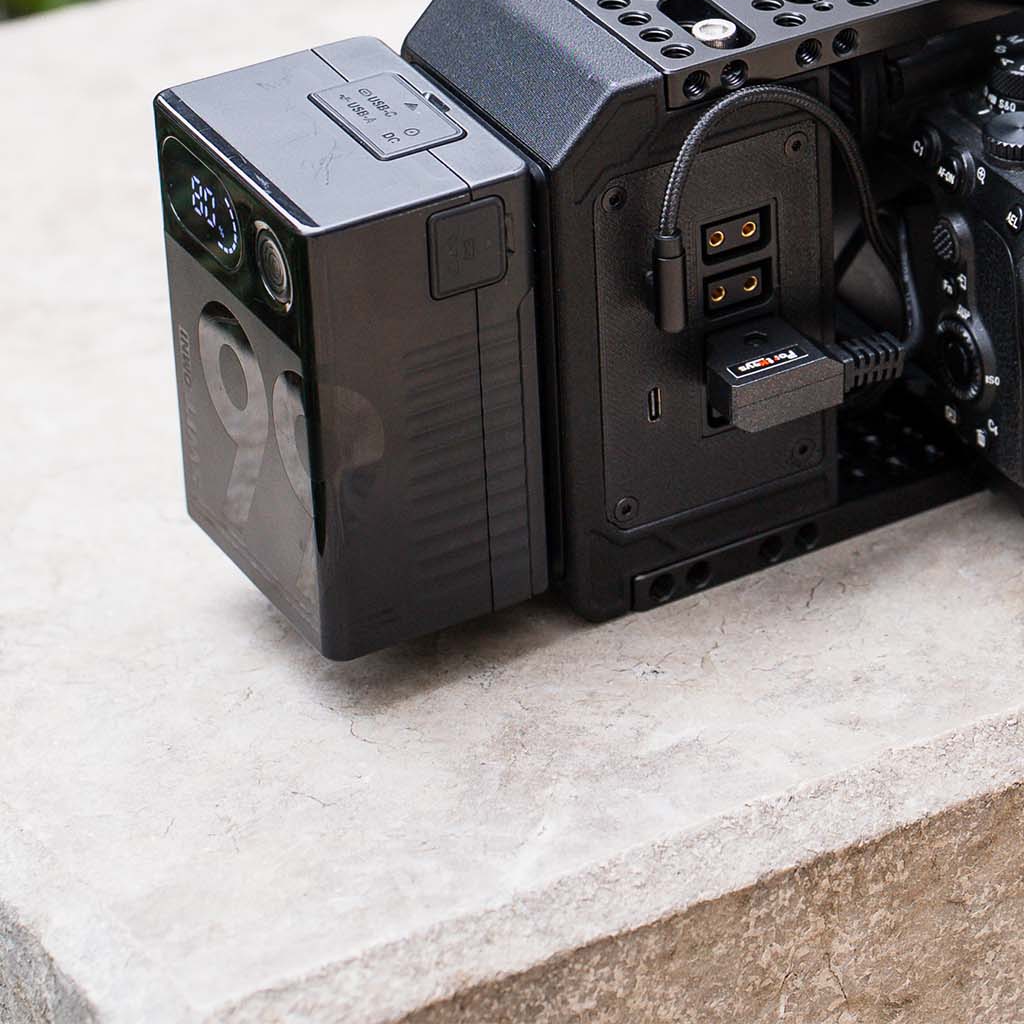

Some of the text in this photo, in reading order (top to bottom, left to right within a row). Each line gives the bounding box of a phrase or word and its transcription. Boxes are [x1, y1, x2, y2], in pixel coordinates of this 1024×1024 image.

[347, 101, 376, 125] USB-A
[367, 95, 398, 118] USB-C
[381, 131, 401, 144] DC
[912, 139, 924, 157] C1
[1005, 211, 1018, 230] AEL
[178, 326, 194, 387] OMNI
[984, 374, 1000, 387] ISO
